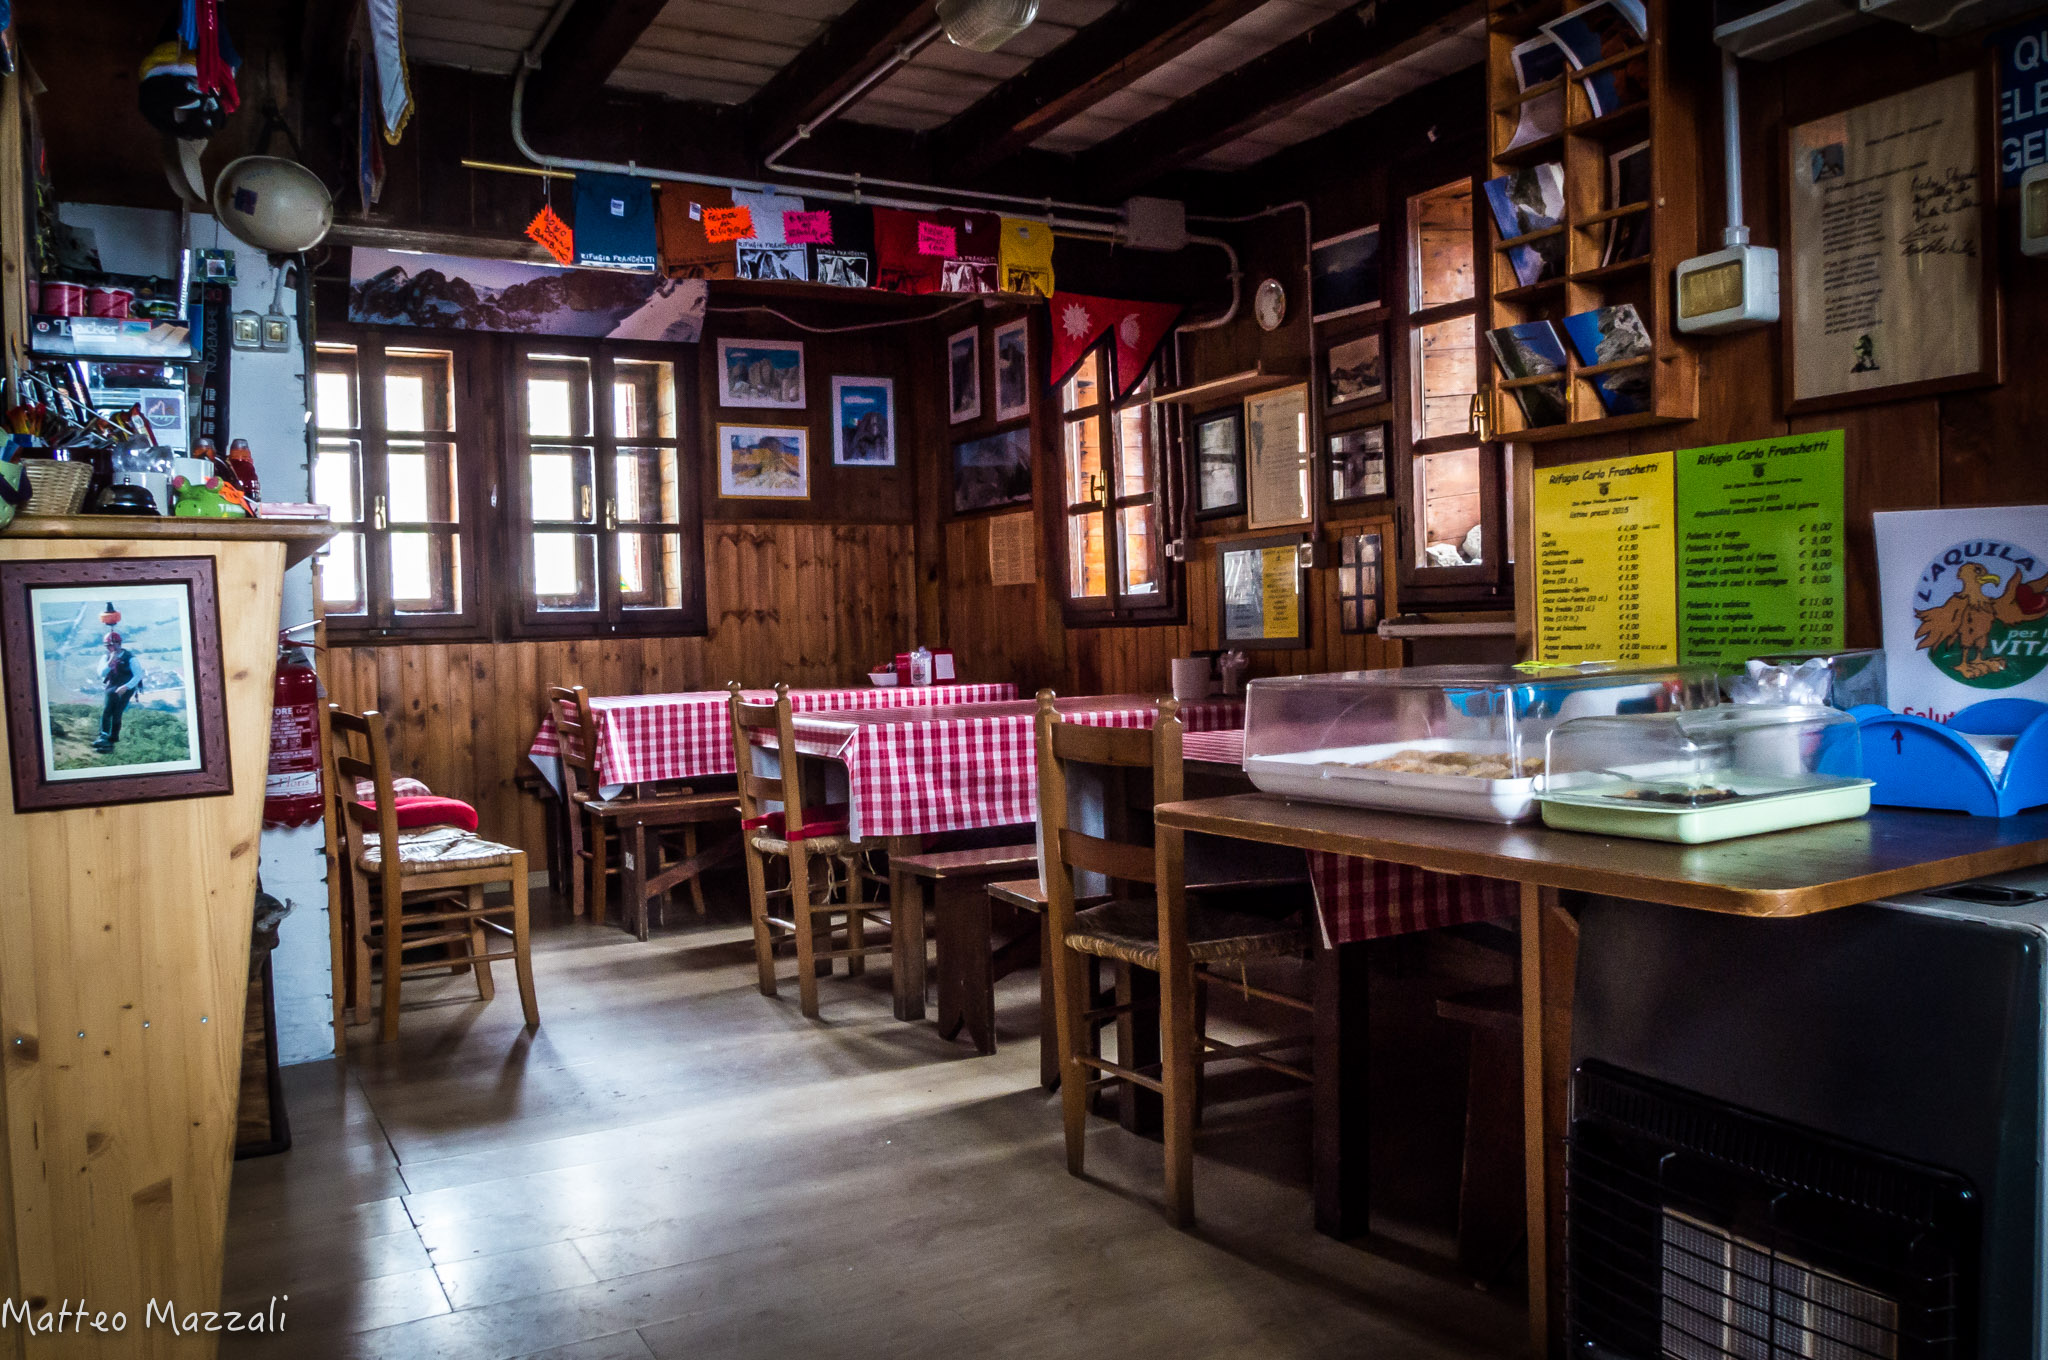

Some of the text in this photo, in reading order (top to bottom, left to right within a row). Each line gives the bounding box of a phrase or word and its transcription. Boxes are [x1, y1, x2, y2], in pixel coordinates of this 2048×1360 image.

[581, 253, 655, 263] RIFUGIO FRANCHETTI
[1697, 440, 1829, 466] Rifugio Carlo Franchetti
[1549, 462, 1659, 485] Rifugio Carlo Franchetti
[1917, 541, 2036, 603] L'AQUILA
[2007, 628, 2038, 640] per
